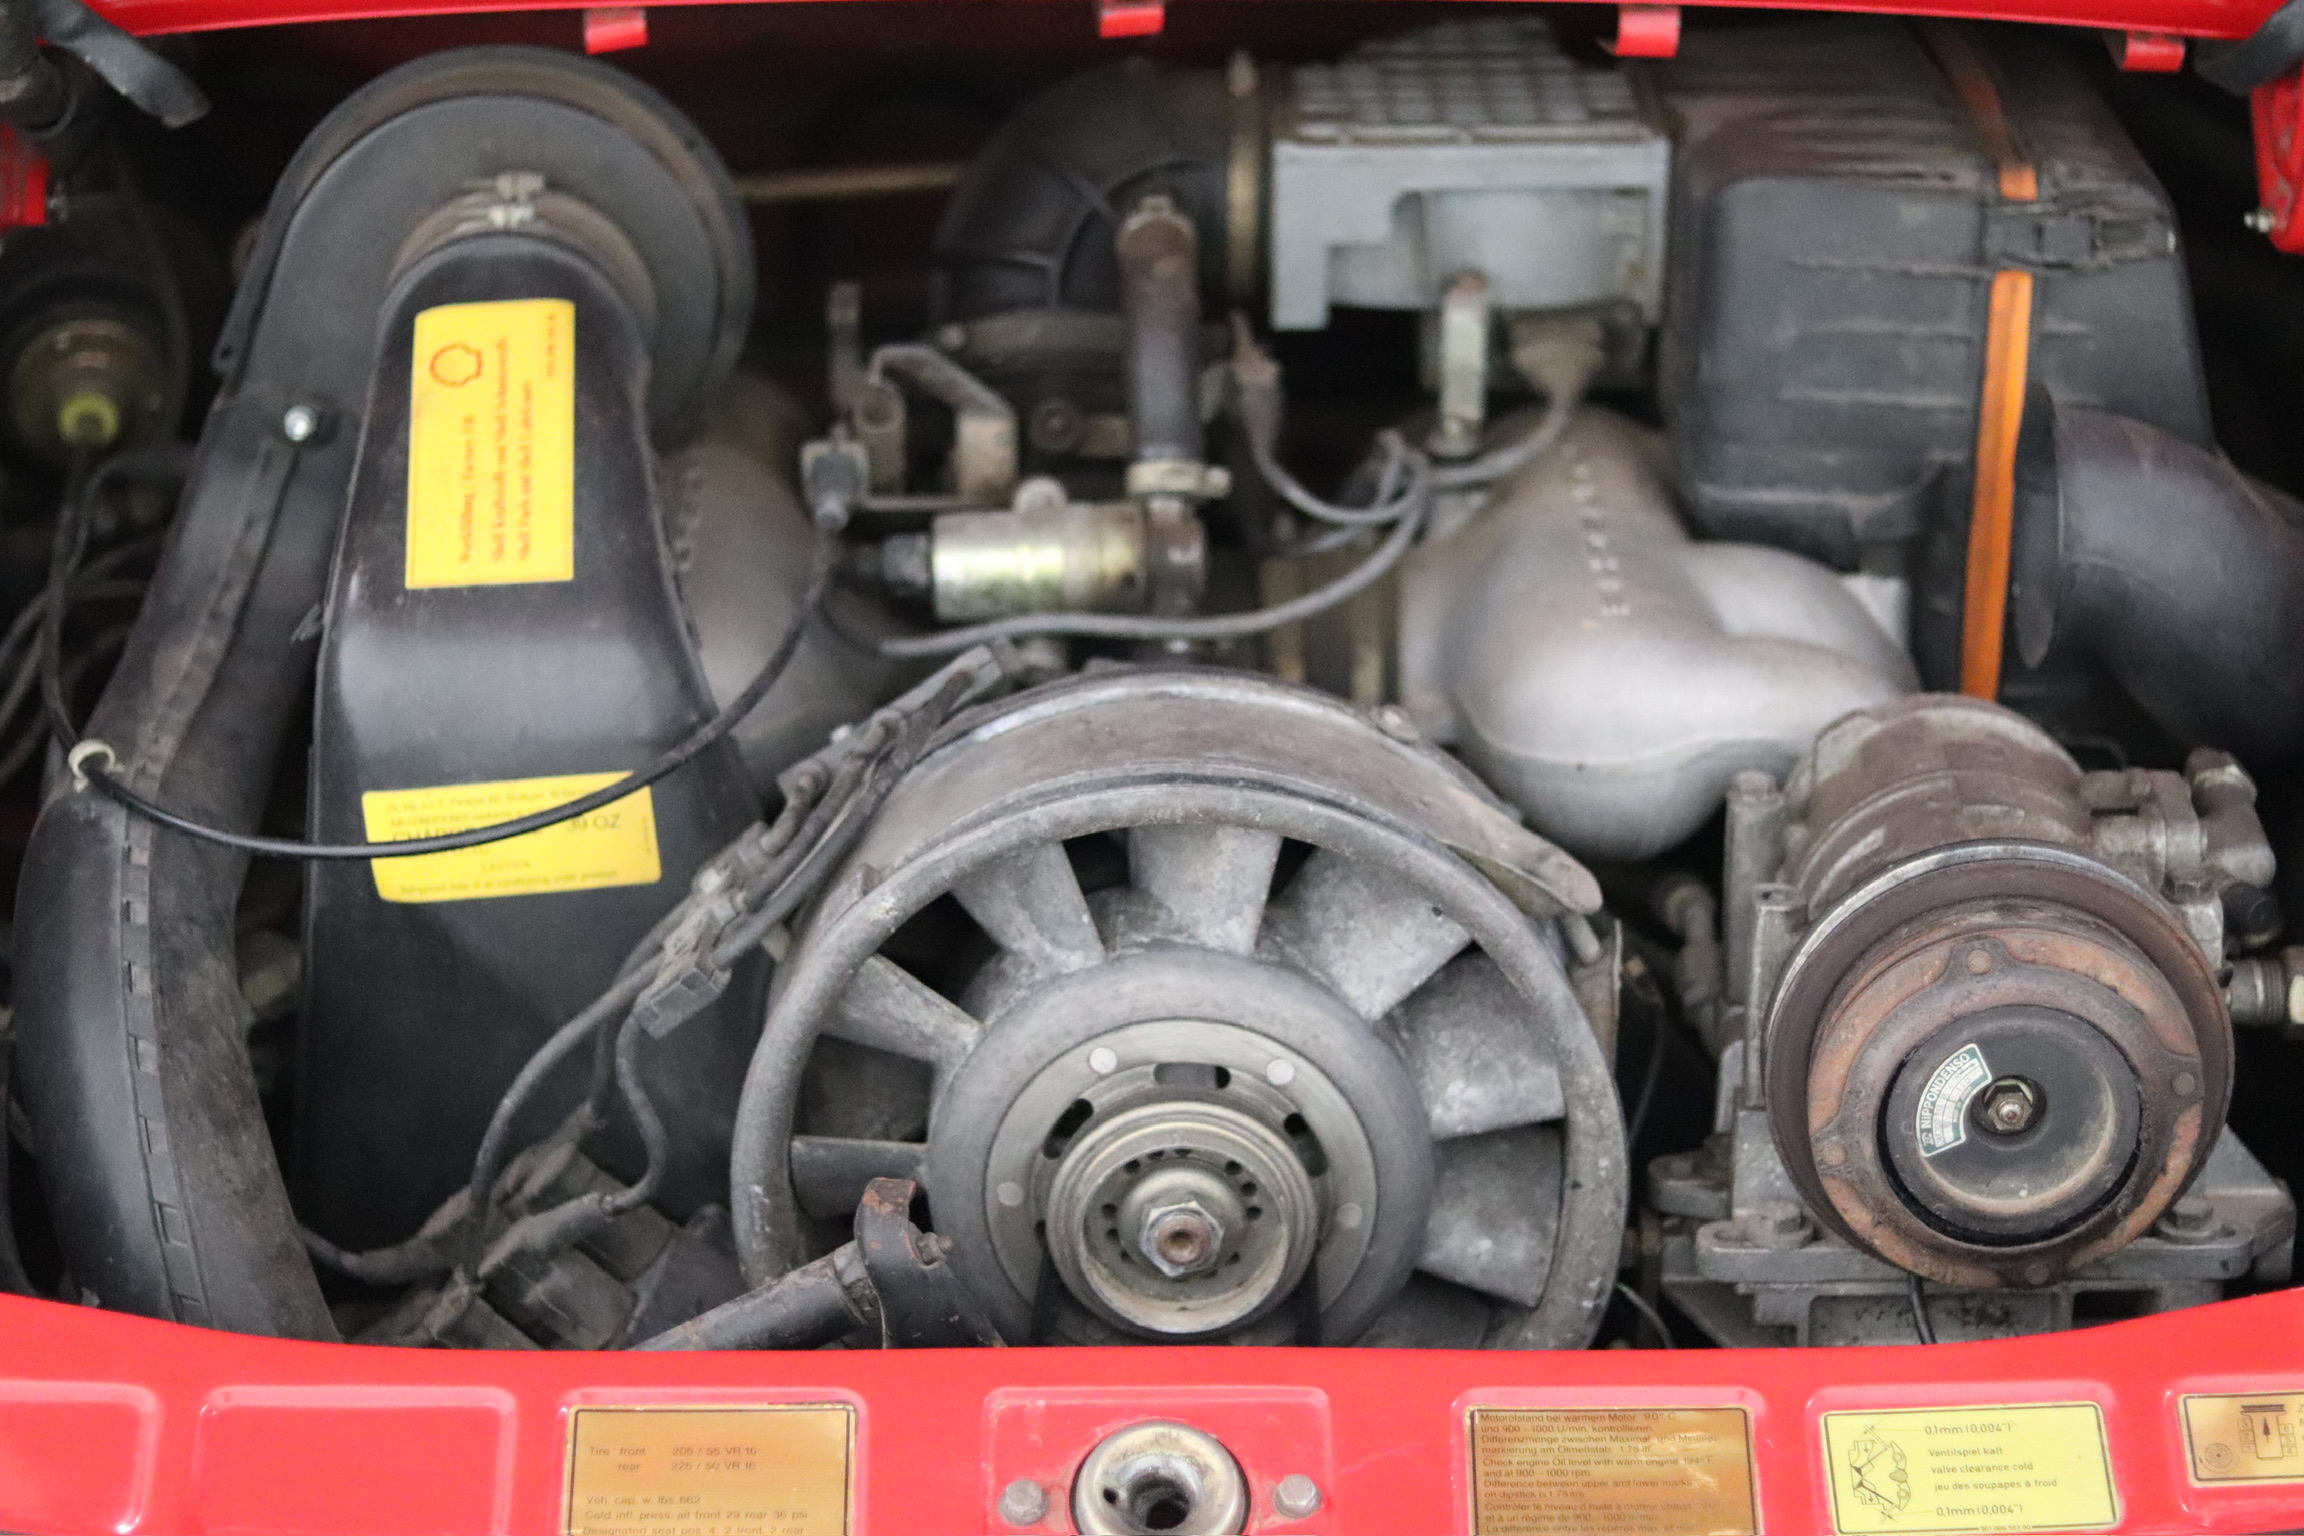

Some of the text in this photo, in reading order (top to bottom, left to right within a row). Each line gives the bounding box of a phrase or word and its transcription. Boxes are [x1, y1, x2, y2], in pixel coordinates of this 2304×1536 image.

[1921, 1053, 1970, 1129] NIPPONDENSO
[1480, 1414, 1543, 1422] Motorölstand
[1546, 1414, 1561, 1422] bei
[1563, 1414, 1606, 1422] warmem
[1608, 1413, 1636, 1422] Motor
[1481, 1425, 1499, 1433] und
[1501, 1425, 1520, 1433] 900
[1481, 1435, 1559, 1444] Differenzmenge
[1562, 1435, 1606, 1443] zwischen
[590, 1446, 645, 1456] Tire front
[672, 1446, 693, 1456] 205
[725, 1447, 741, 1455] VR
[745, 1446, 757, 1456] 16
[1482, 1446, 1537, 1455] markierung
[1929, 1447, 2004, 1458] Ventilspiel kalt
[618, 1462, 640, 1471] rear
[671, 1462, 692, 1471] 225
[705, 1461, 720, 1471] 50
[724, 1461, 740, 1470] VR
[745, 1461, 756, 1470] 16
[1483, 1458, 1513, 1467] Check
[1516, 1459, 1550, 1467] engine
[1552, 1458, 1566, 1466] Oil
[1568, 1458, 1591, 1466] level
[1593, 1458, 1613, 1466] with
[1931, 1462, 2033, 1474] valve clearance cold
[1483, 1469, 1501, 1477] and
[1516, 1469, 1535, 1477] 900
[1546, 1469, 1569, 1477] 1000
[1571, 1470, 1591, 1478] rpm
[1484, 1480, 1534, 1488] Difference
[1536, 1480, 1579, 1488] between
[1581, 1481, 1609, 1489] upper
[1612, 1479, 1631, 1487] and
[1632, 1479, 1659, 1487] lower
[1934, 1479, 2057, 1492] jeu des soupapes à froid
[1499, 1491, 1536, 1500] dipstick
[679, 1496, 701, 1505] 662
[1533, 1503, 1542, 1511] le
[1544, 1503, 1577, 1511] niveau
[1624, 1503, 1657, 1511] moteur
[585, 1511, 611, 1520] Cold
[695, 1510, 720, 1520] front
[745, 1511, 767, 1520] rear
[792, 1511, 808, 1521] psi
[1485, 1514, 1495, 1522] et
[1558, 1514, 1570, 1522] de
[1573, 1513, 1592, 1522] 900
[1604, 1513, 1626, 1521] 1000
[583, 1526, 646, 1536] Designated
[652, 1527, 676, 1535] seat
[725, 1527, 732, 1535] 2
[770, 1527, 777, 1535] 2
[1486, 1525, 1498, 1533] La
[1580, 1524, 1595, 1532] les
